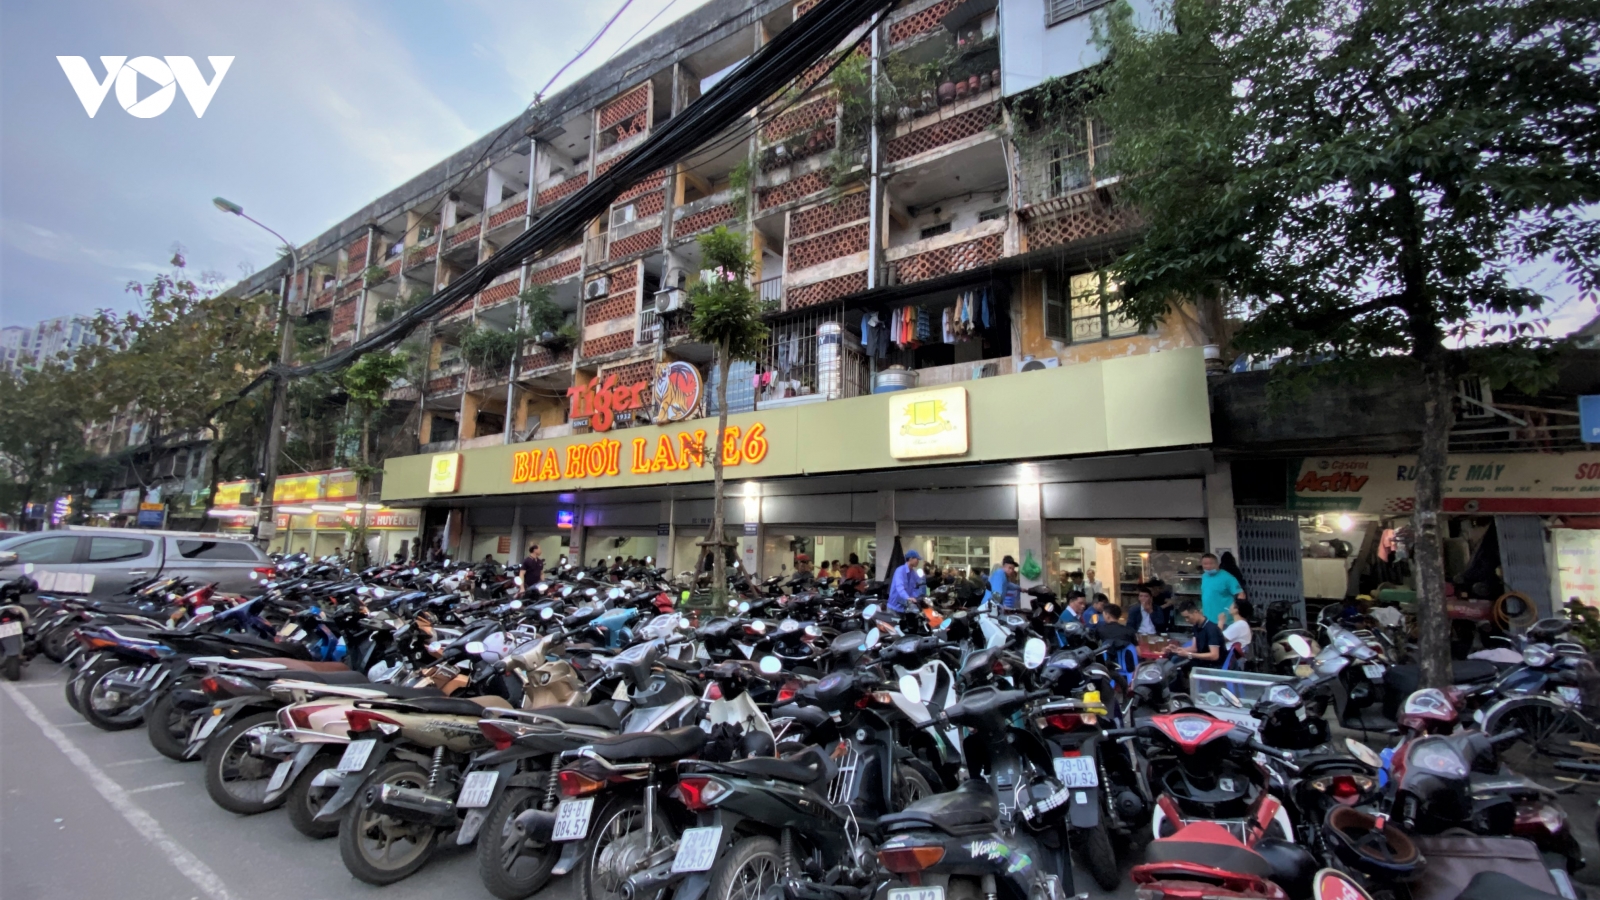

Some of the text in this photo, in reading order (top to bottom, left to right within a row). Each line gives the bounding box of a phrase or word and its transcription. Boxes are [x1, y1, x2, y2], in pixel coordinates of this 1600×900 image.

[568, 374, 648, 432] Tiger
[573, 413, 632, 428] SINCE 1932
[512, 422, 768, 484] BIA HƠI LAN E6
[1331, 461, 1369, 470] Castrol
[1465, 461, 1505, 481] MÁY
[1294, 470, 1369, 492] Activ
[561, 801, 588, 819] 99-B1
[555, 819, 587, 837] 084.57
[971, 840, 1000, 859] Wave
